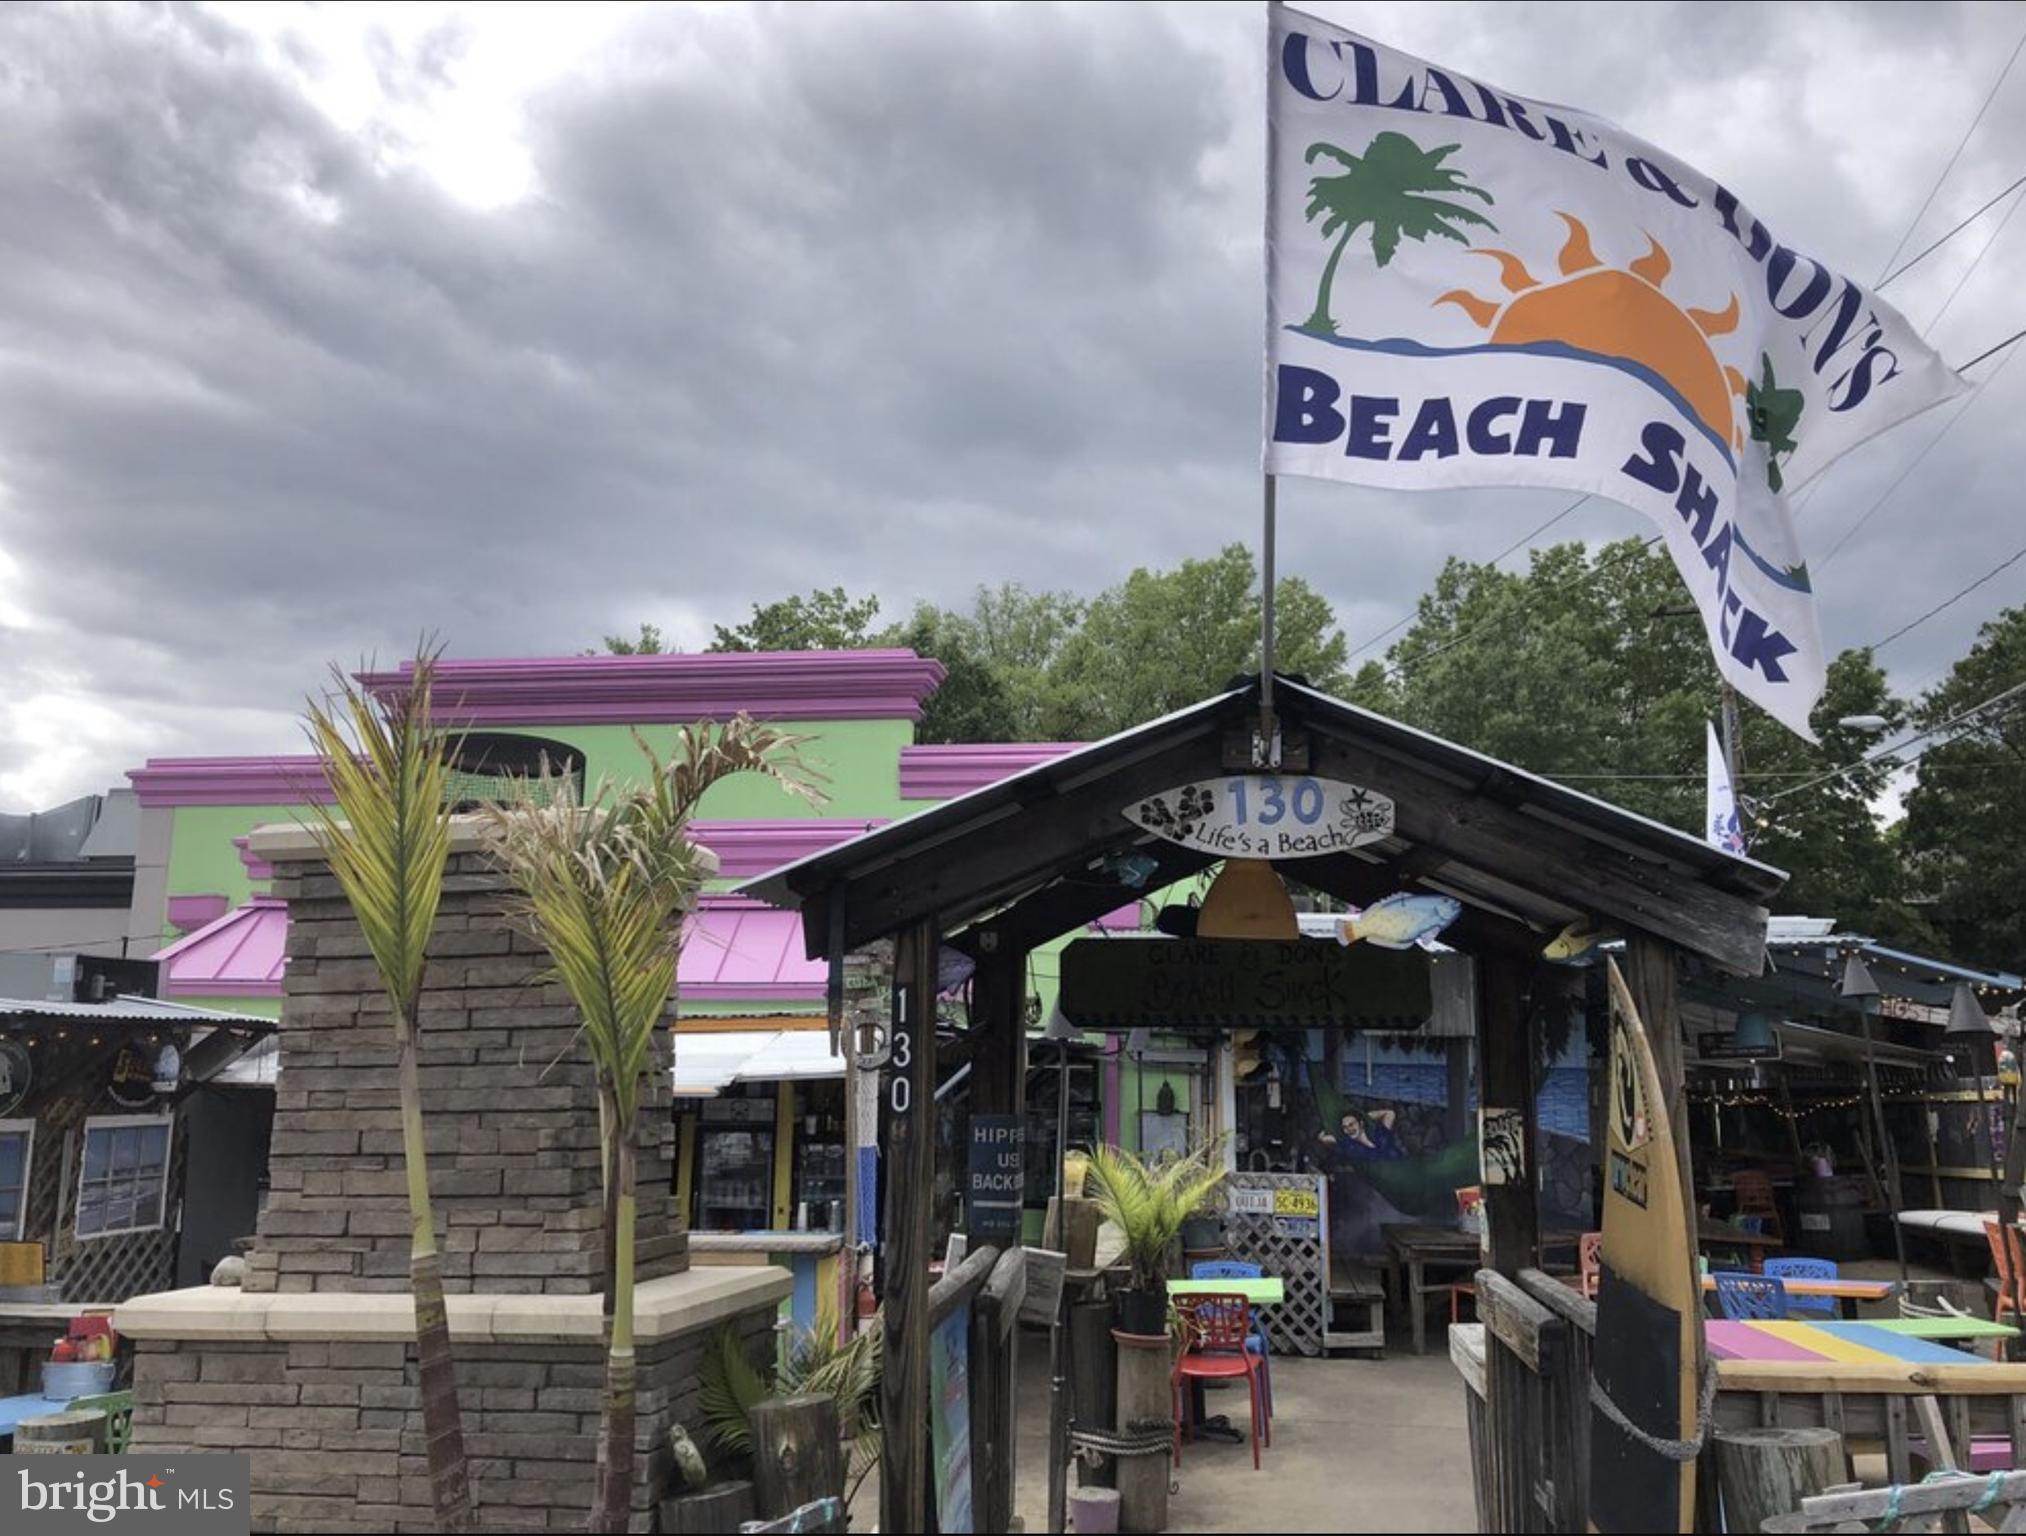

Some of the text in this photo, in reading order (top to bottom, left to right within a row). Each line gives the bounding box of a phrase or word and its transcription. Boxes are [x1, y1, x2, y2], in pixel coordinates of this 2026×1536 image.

[1281, 30, 1609, 170] CLARE
[1623, 155, 1700, 209] &
[1272, 363, 1588, 461] BEACH
[1195, 822, 1346, 855] Life's a Beach
[1227, 776, 1325, 827] 130
[1147, 943, 1221, 966] CLARE
[890, 987, 912, 1113] 130
